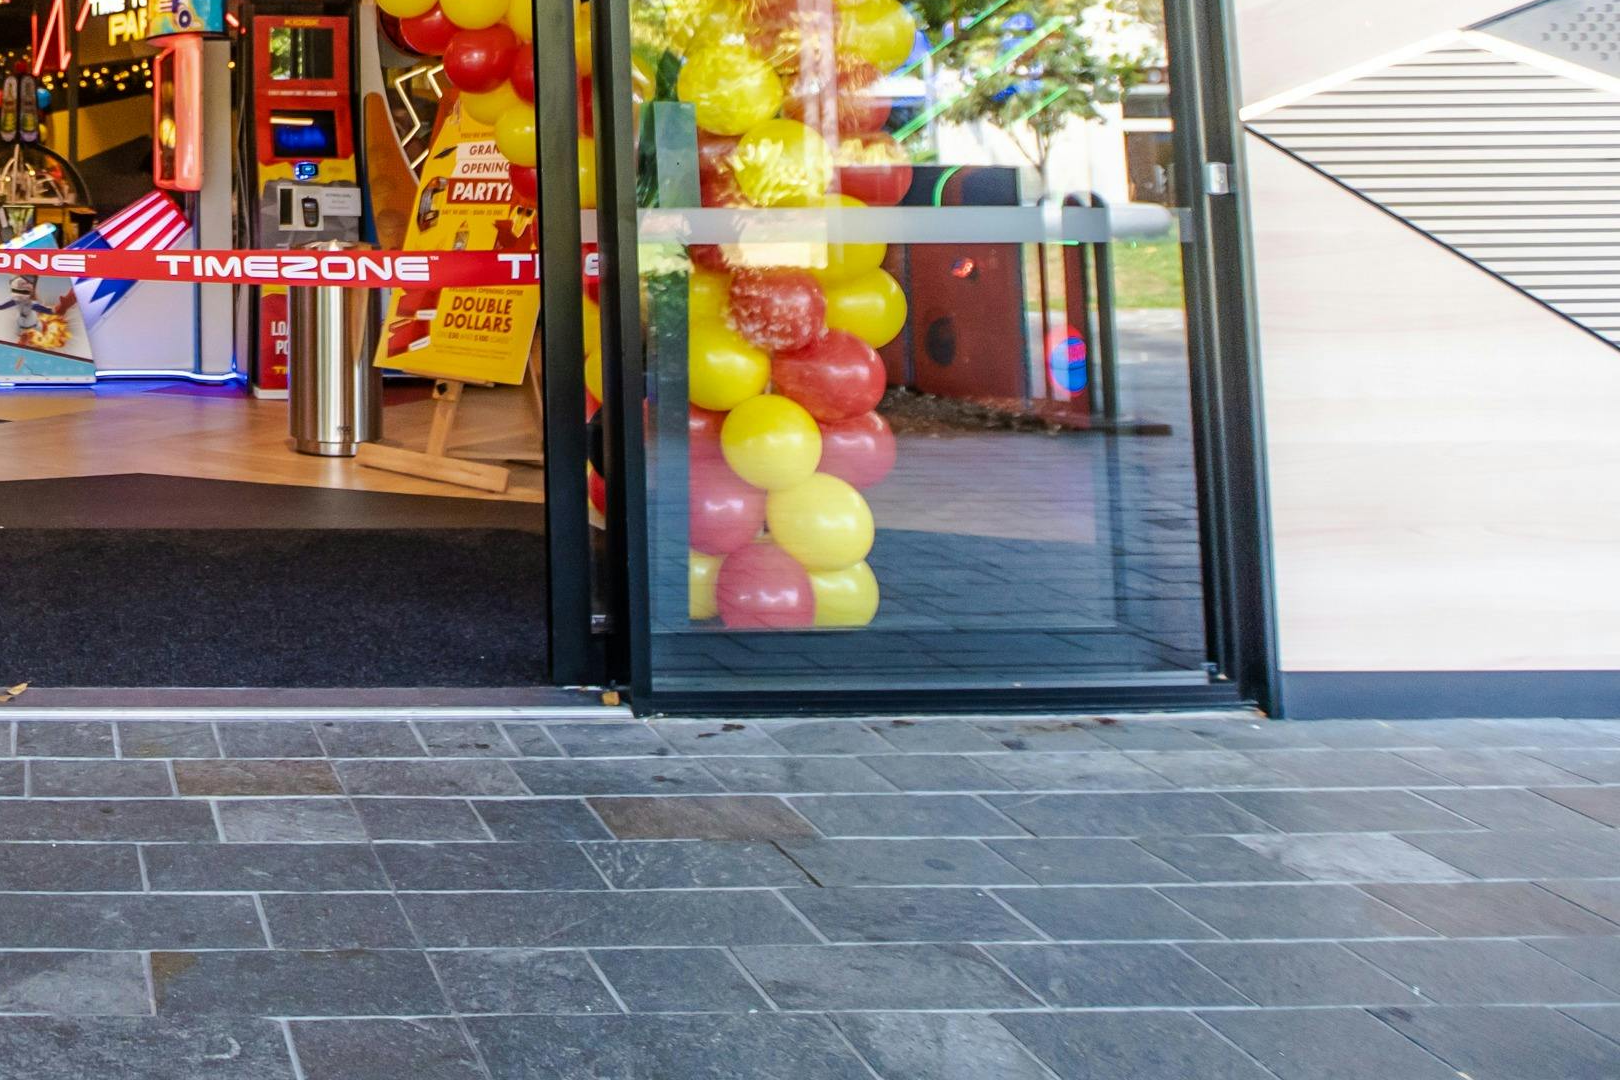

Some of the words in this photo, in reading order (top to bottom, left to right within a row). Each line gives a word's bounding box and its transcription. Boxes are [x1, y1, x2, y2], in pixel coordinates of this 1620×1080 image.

[451, 182, 514, 201] PARTY!
[156, 254, 430, 282] TIMEZONE
[452, 295, 514, 315] DOUBLE
[443, 312, 513, 333] DOLLARS
